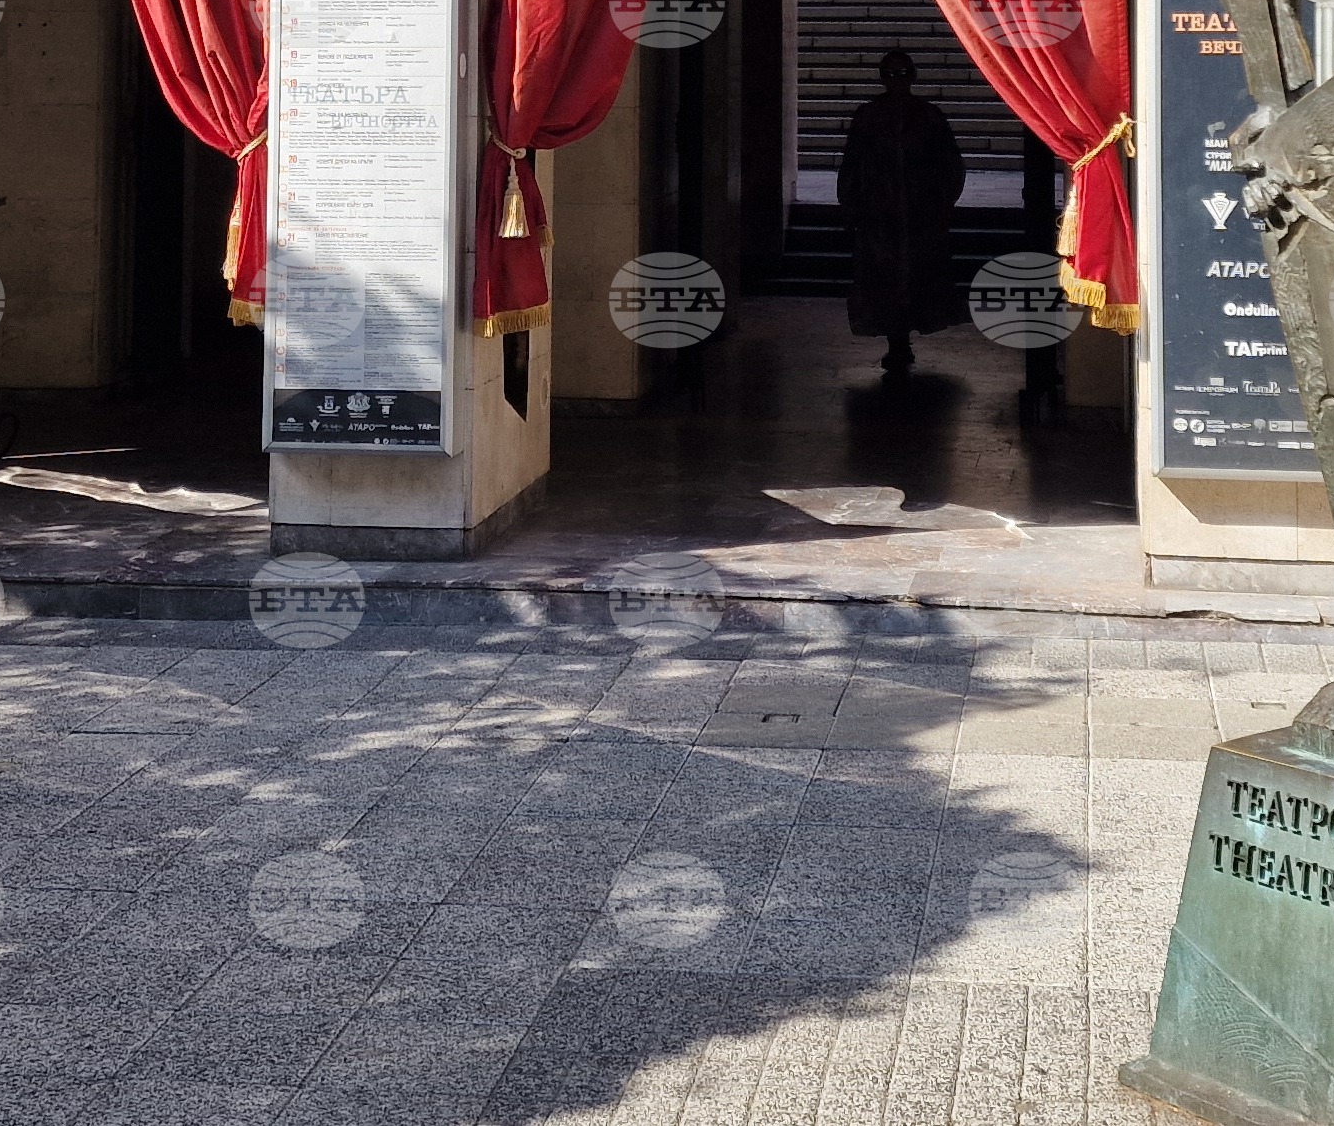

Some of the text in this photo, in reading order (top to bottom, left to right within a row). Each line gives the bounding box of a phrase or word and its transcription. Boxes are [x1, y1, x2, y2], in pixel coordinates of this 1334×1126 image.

[288, 85, 410, 104] ТЕАТЪРА
[288, 154, 298, 164] 20
[287, 191, 296, 201] 21
